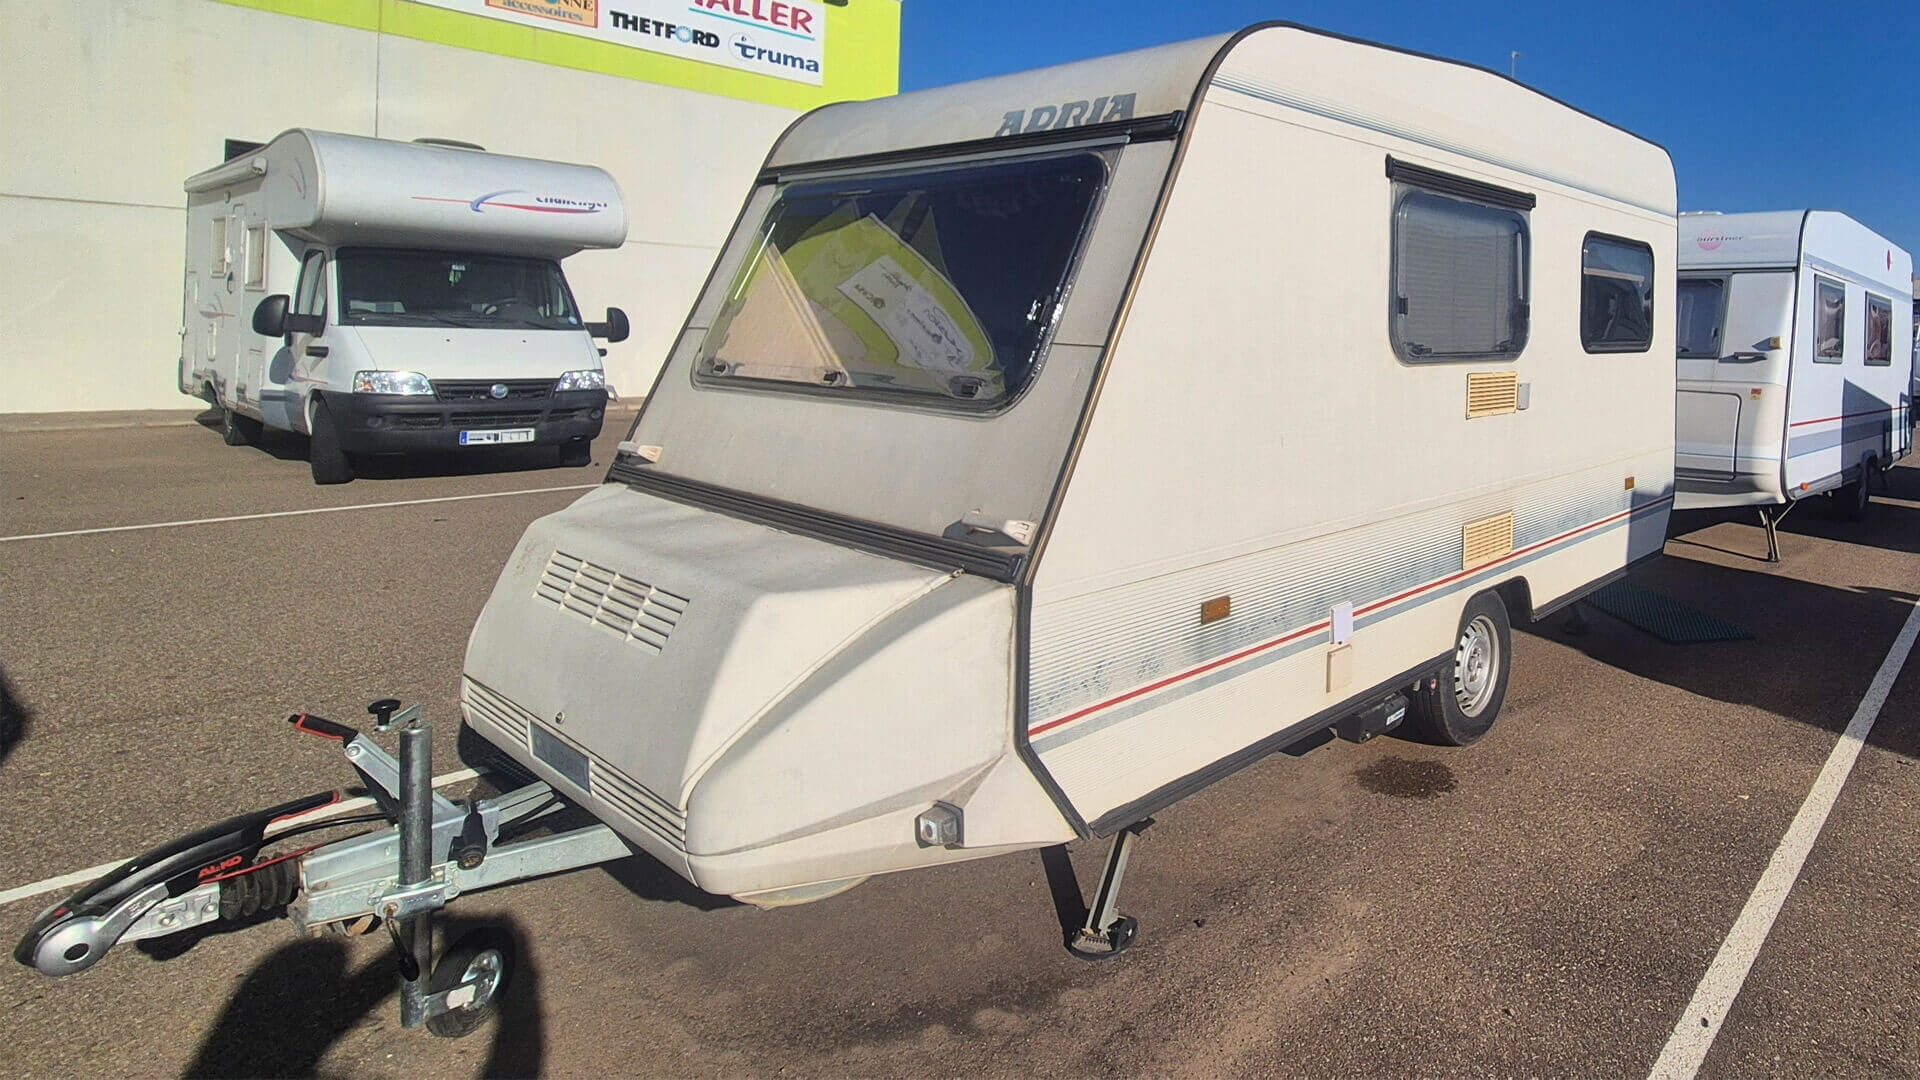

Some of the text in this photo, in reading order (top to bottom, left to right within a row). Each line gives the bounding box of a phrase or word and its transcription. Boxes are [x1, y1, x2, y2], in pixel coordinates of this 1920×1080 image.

[609, 10, 720, 48] THETFORD
[734, 37, 819, 72] truma
[995, 93, 1137, 136] ADRIA
